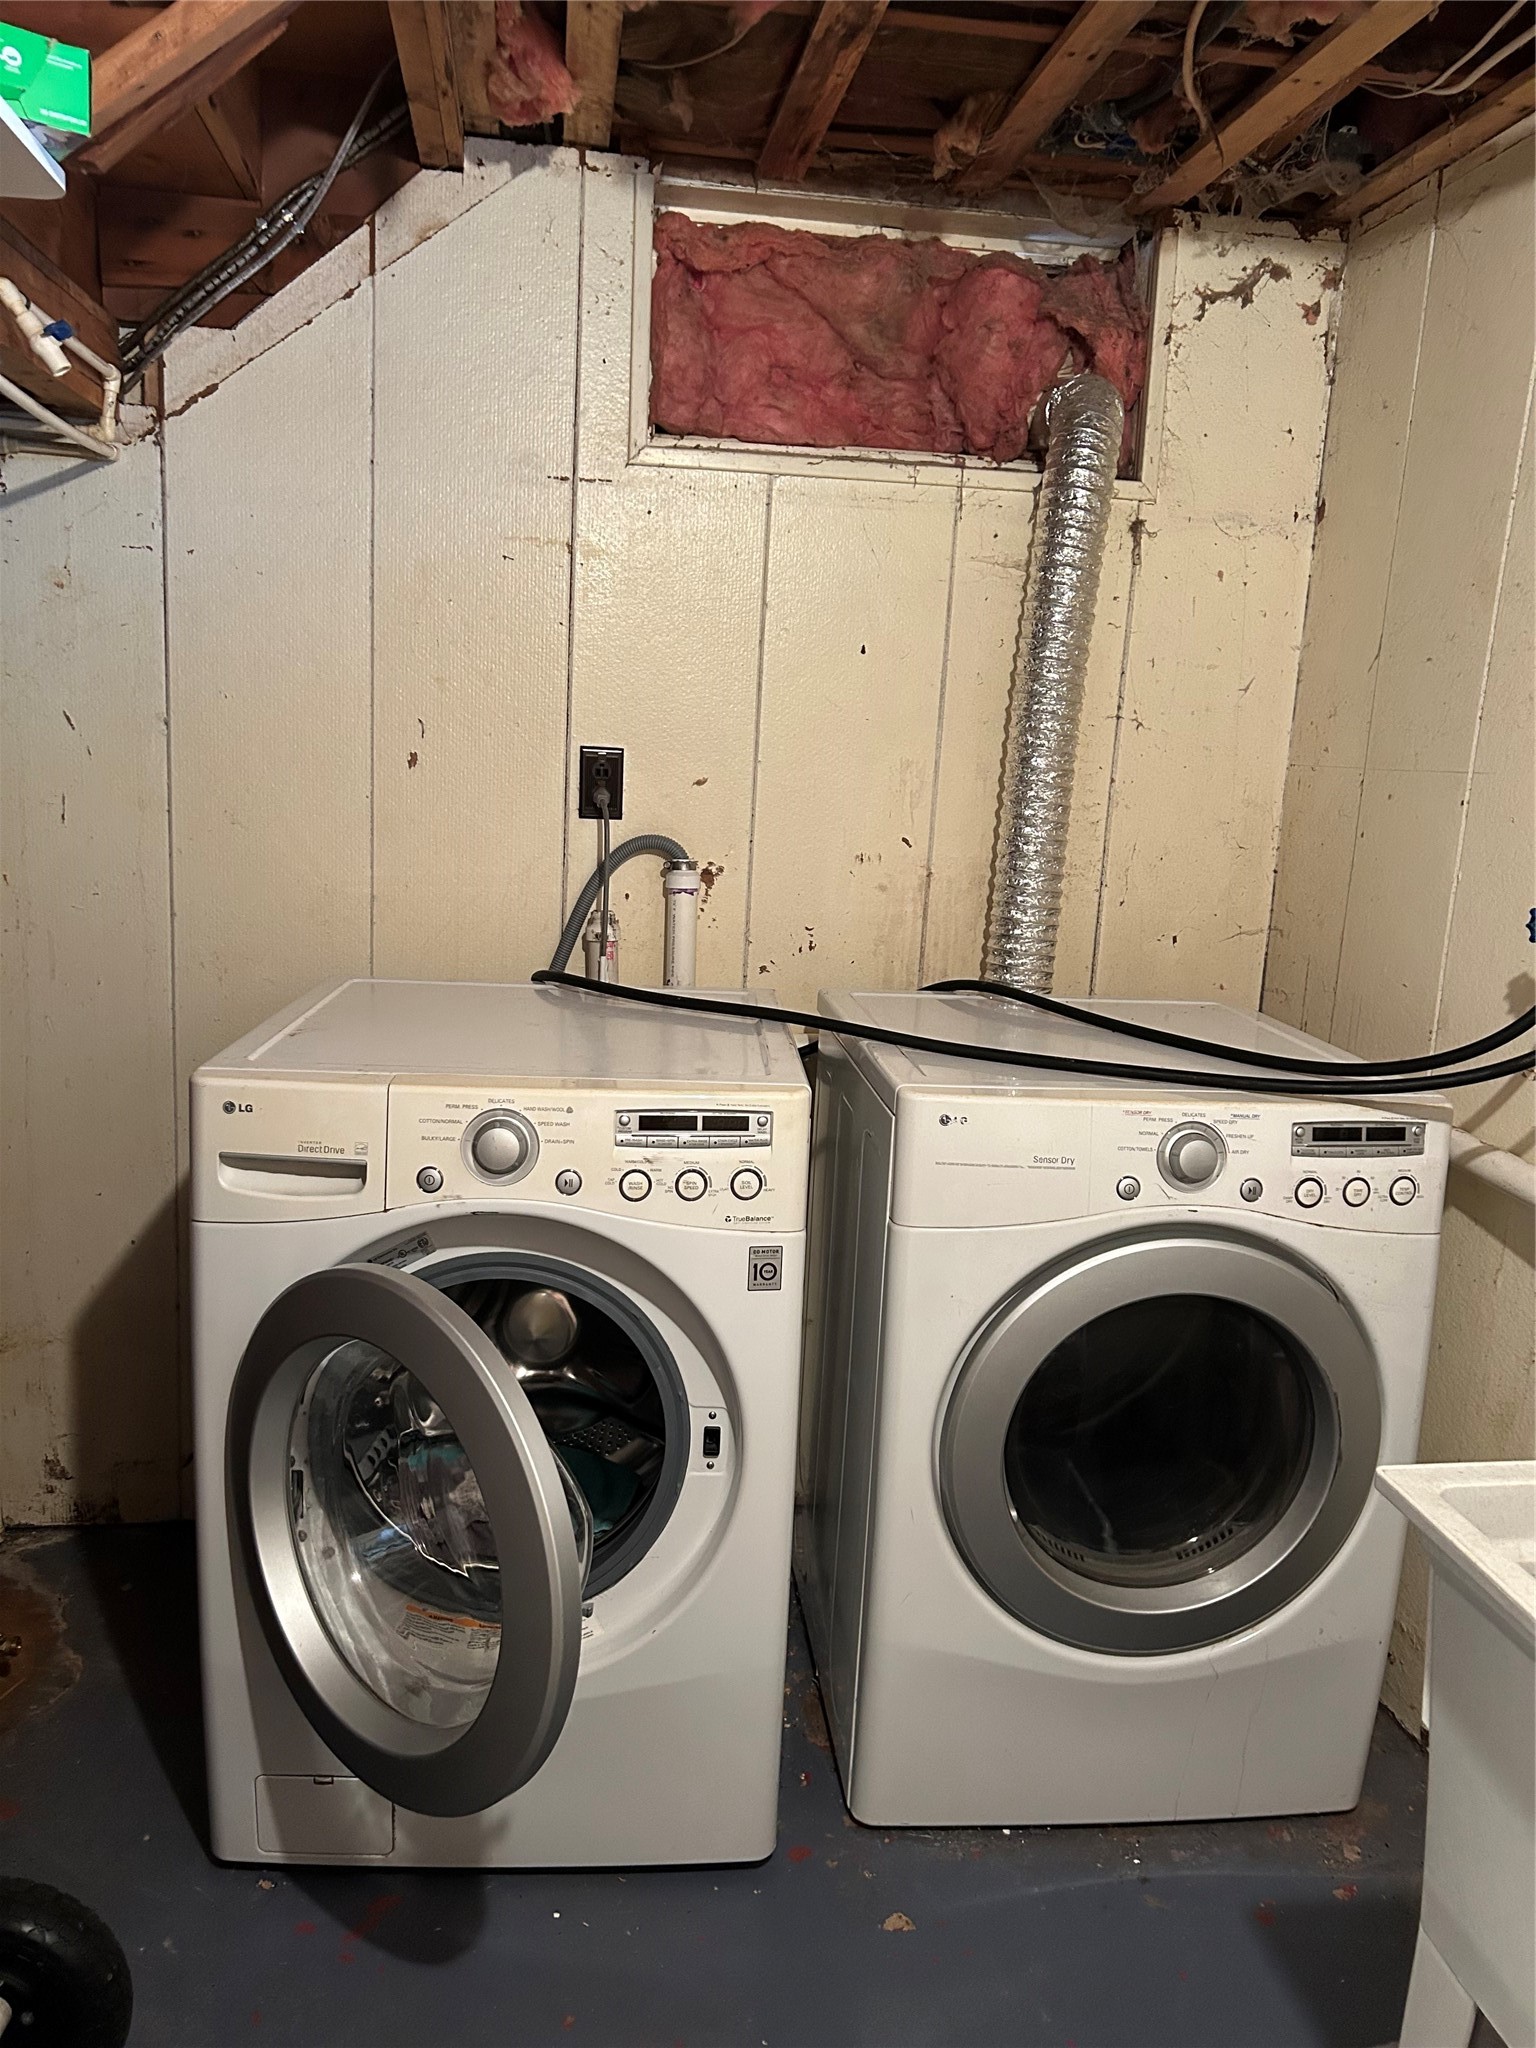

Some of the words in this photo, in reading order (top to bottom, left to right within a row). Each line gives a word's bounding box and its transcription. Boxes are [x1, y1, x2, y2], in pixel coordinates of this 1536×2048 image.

[238, 1103, 254, 1113] LG
[1032, 1155, 1060, 1165] Sensor
[1060, 1156, 1076, 1166] Dry
[752, 1262, 778, 1281] 10
